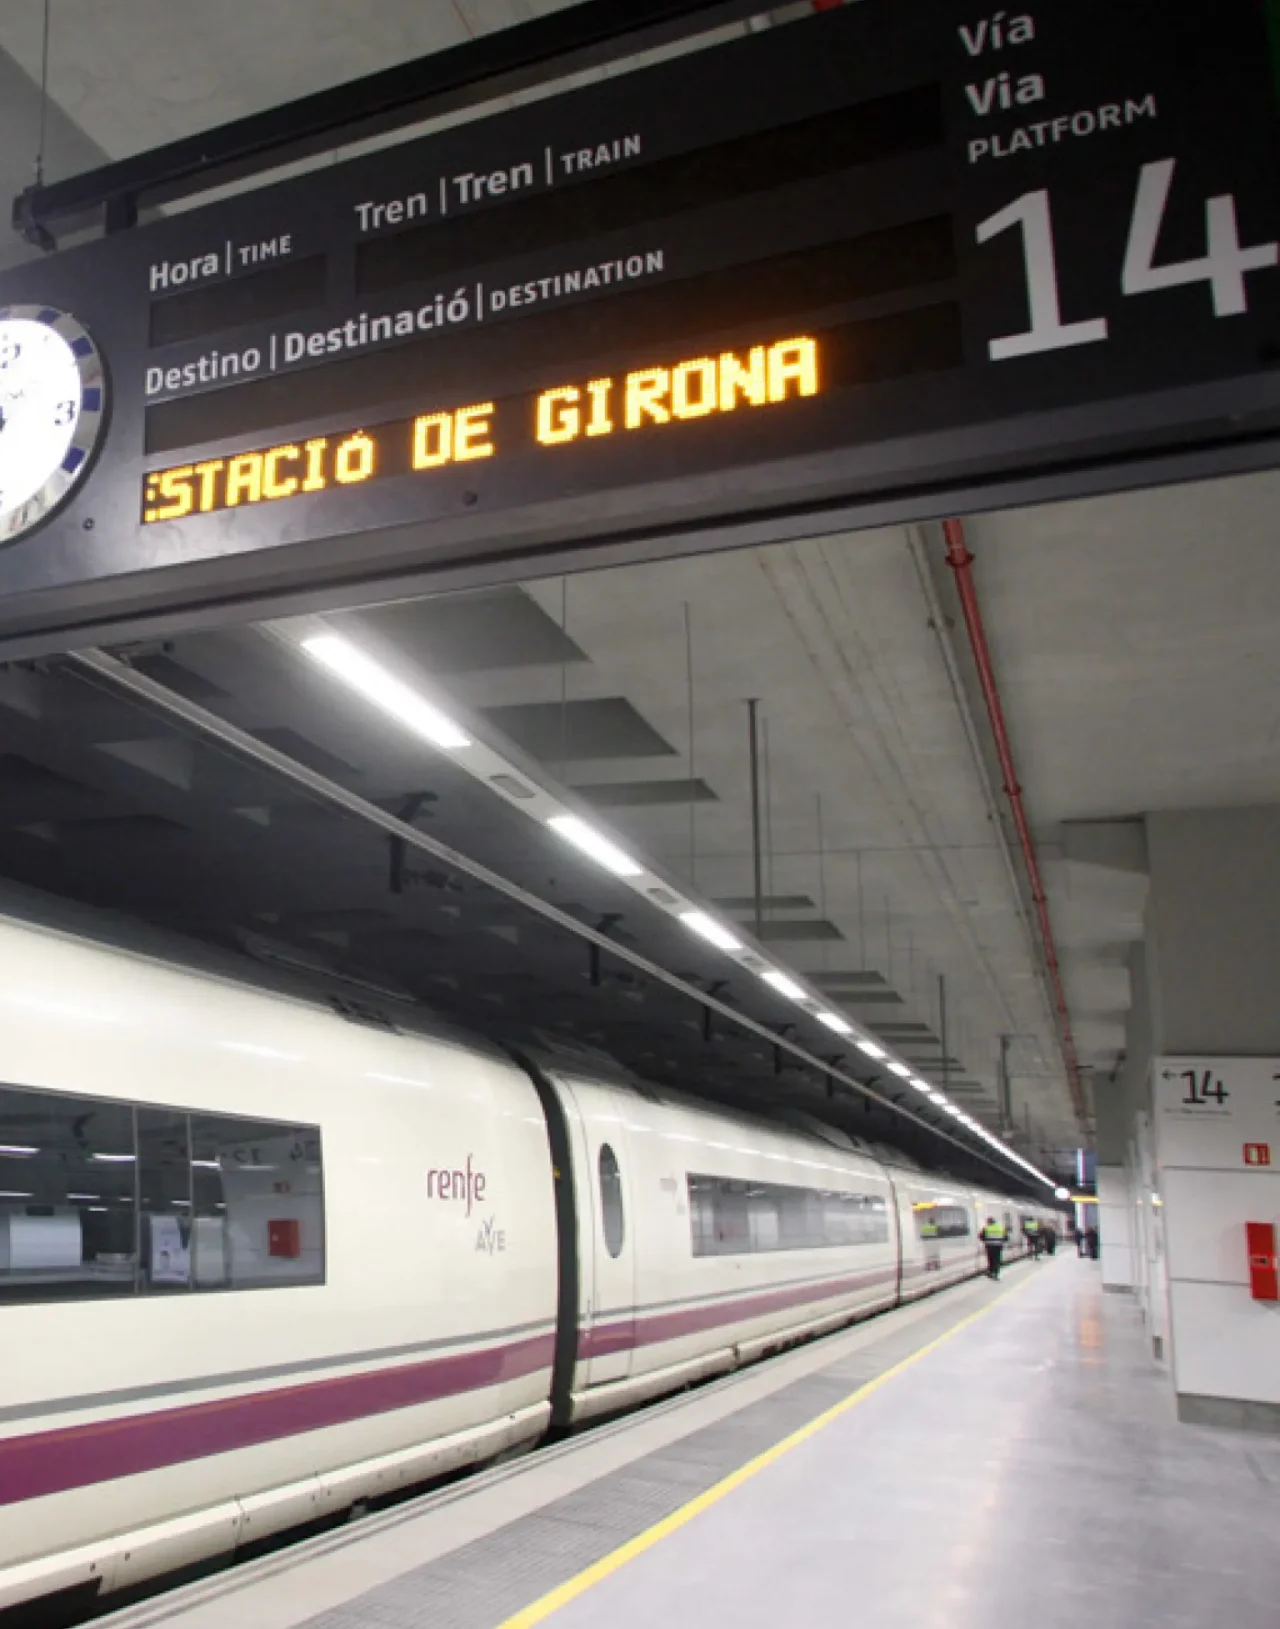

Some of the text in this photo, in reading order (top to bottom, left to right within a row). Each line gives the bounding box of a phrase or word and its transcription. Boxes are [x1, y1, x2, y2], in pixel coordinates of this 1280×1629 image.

[957, 10, 1036, 56] Vía
[964, 71, 1046, 116] Via
[967, 93, 1158, 164] PLATFORM
[354, 134, 642, 232] Tren Tren TRAIN
[149, 234, 292, 292] Hora TIME
[976, 157, 1279, 361] 14
[144, 250, 665, 396] Destino Destinació DESTINATION
[412, 401, 495, 472] DE
[536, 335, 819, 446] GIRONA
[1180, 1070, 1230, 1105] 14
[426, 1152, 486, 1219] renfe
